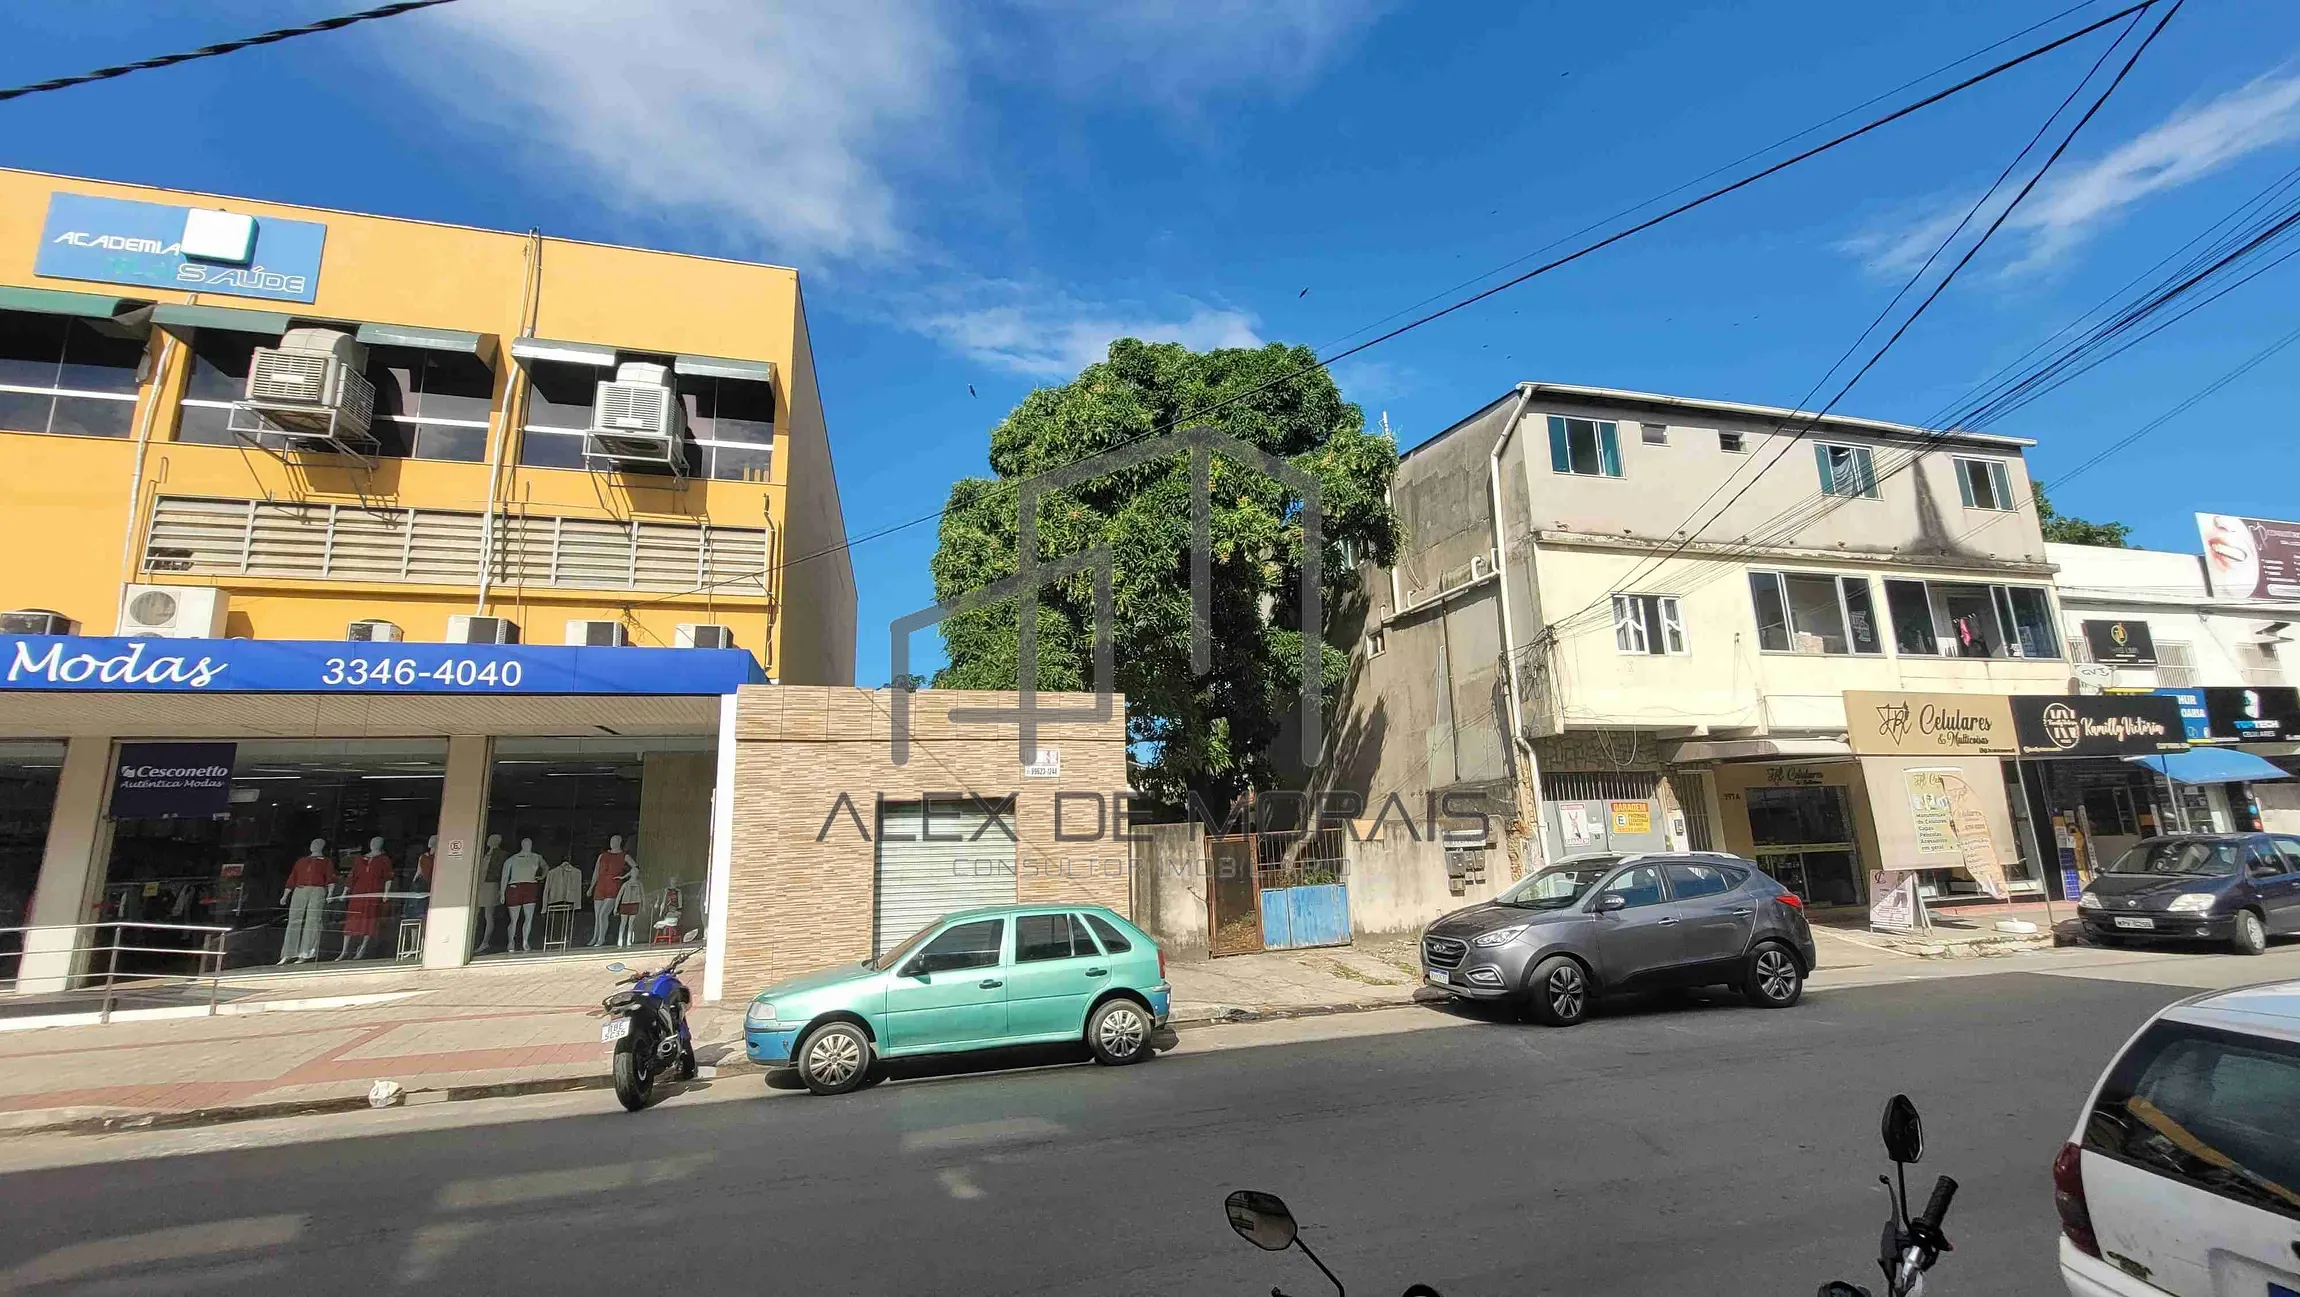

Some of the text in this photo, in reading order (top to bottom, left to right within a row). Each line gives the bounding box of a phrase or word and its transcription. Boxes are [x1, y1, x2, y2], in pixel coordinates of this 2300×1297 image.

[54, 231, 181, 256] ACADEMIA
[177, 264, 306, 293] SAÚDE
[7, 641, 522, 687] Modas 3346-4040
[1920, 704, 1992, 735] Celulares
[137, 765, 228, 777] Cesconetto
[183, 779, 224, 788] Modas
